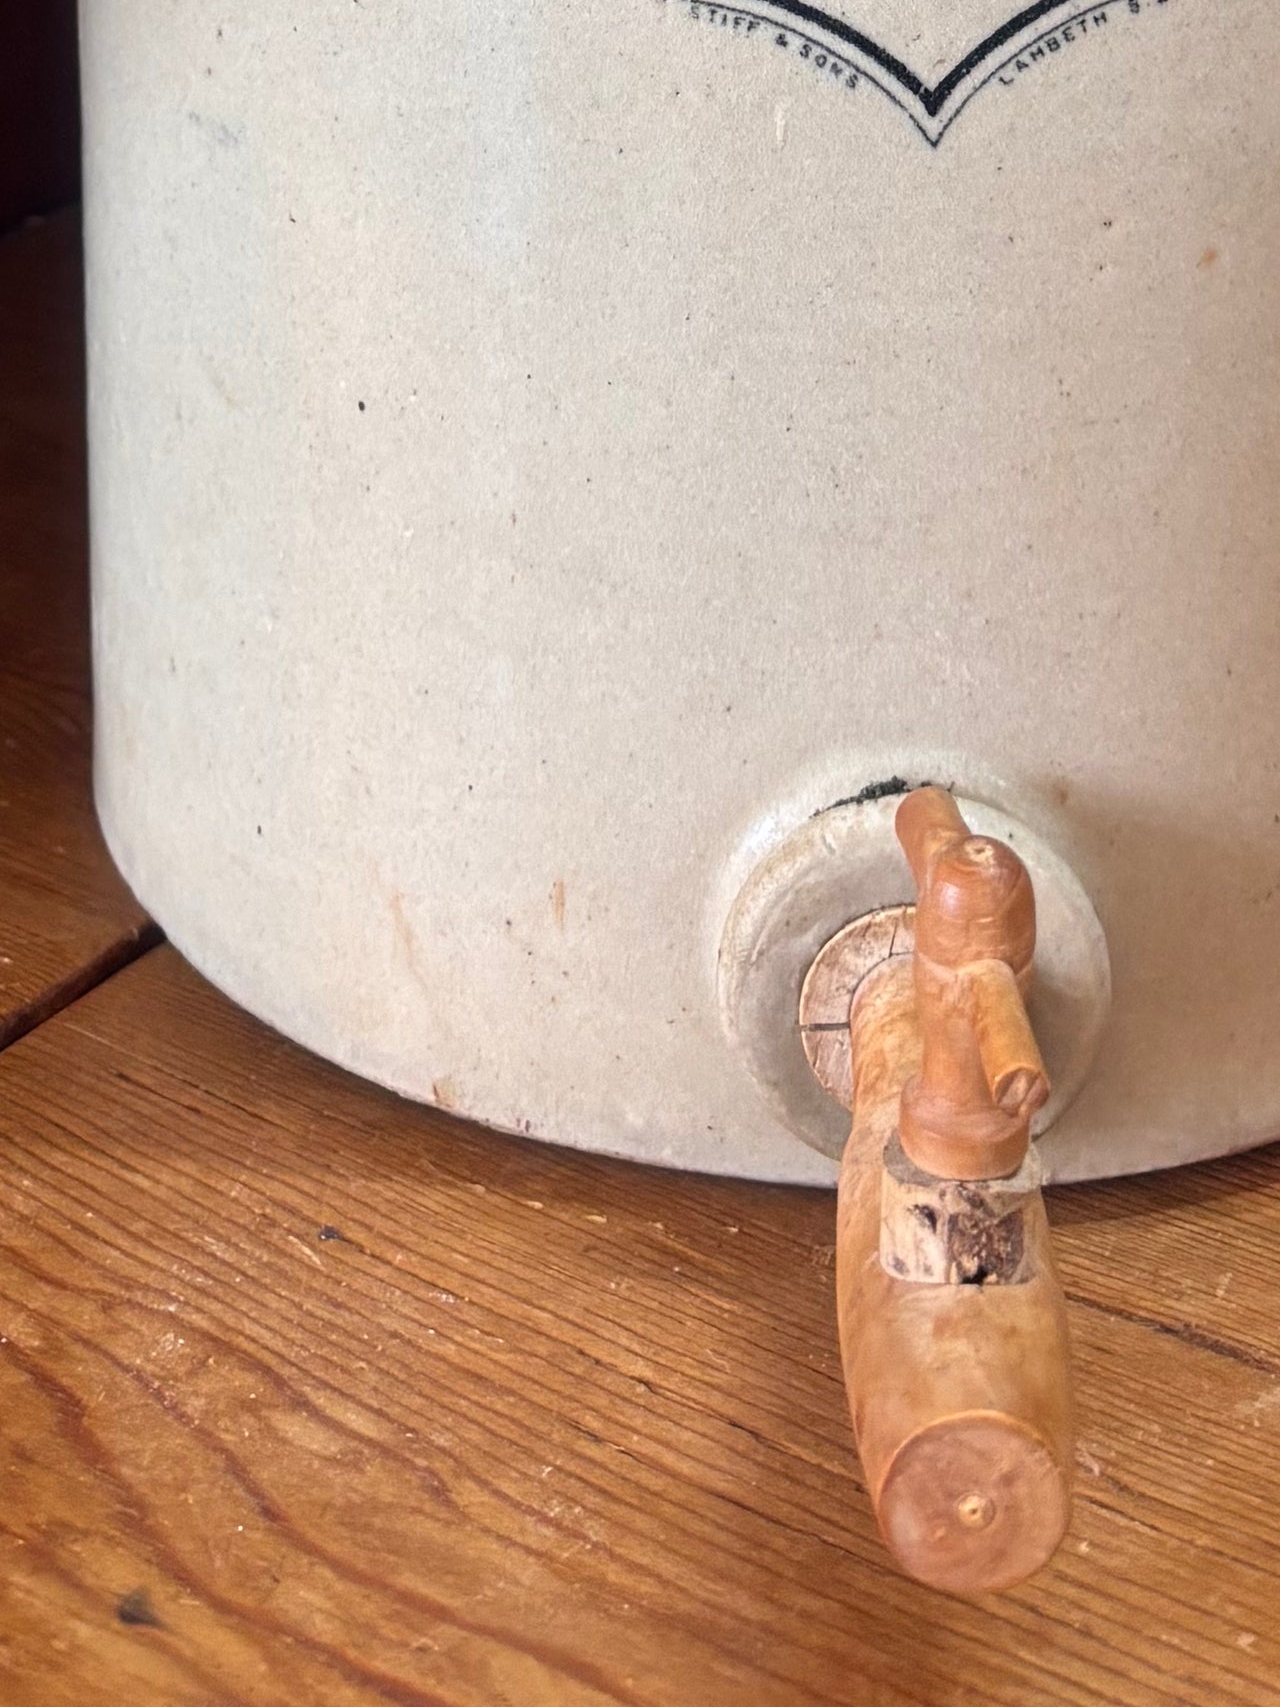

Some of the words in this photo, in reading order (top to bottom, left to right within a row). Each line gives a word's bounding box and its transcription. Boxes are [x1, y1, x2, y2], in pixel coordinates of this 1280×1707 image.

[689, 4, 761, 32] STIFF
[774, 33, 789, 48] &
[798, 43, 859, 89] SONS
[997, 11, 1108, 86] LAMBETH
